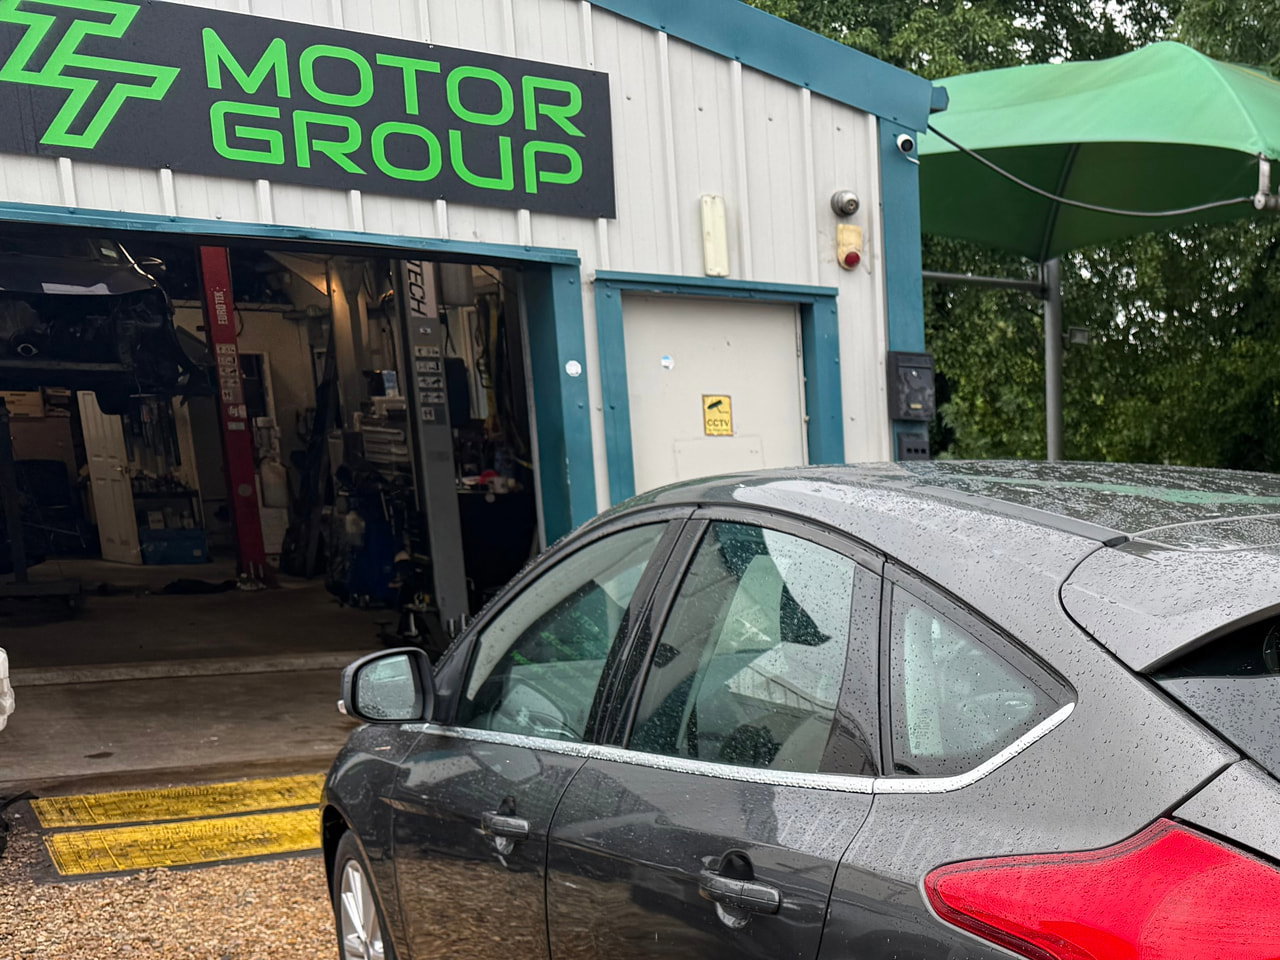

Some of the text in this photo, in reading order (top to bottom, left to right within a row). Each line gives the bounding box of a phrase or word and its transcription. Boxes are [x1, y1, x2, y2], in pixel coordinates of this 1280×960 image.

[202, 27, 586, 137] MOTOR
[209, 101, 584, 194] GROUP
[707, 418, 730, 428] CCTV
